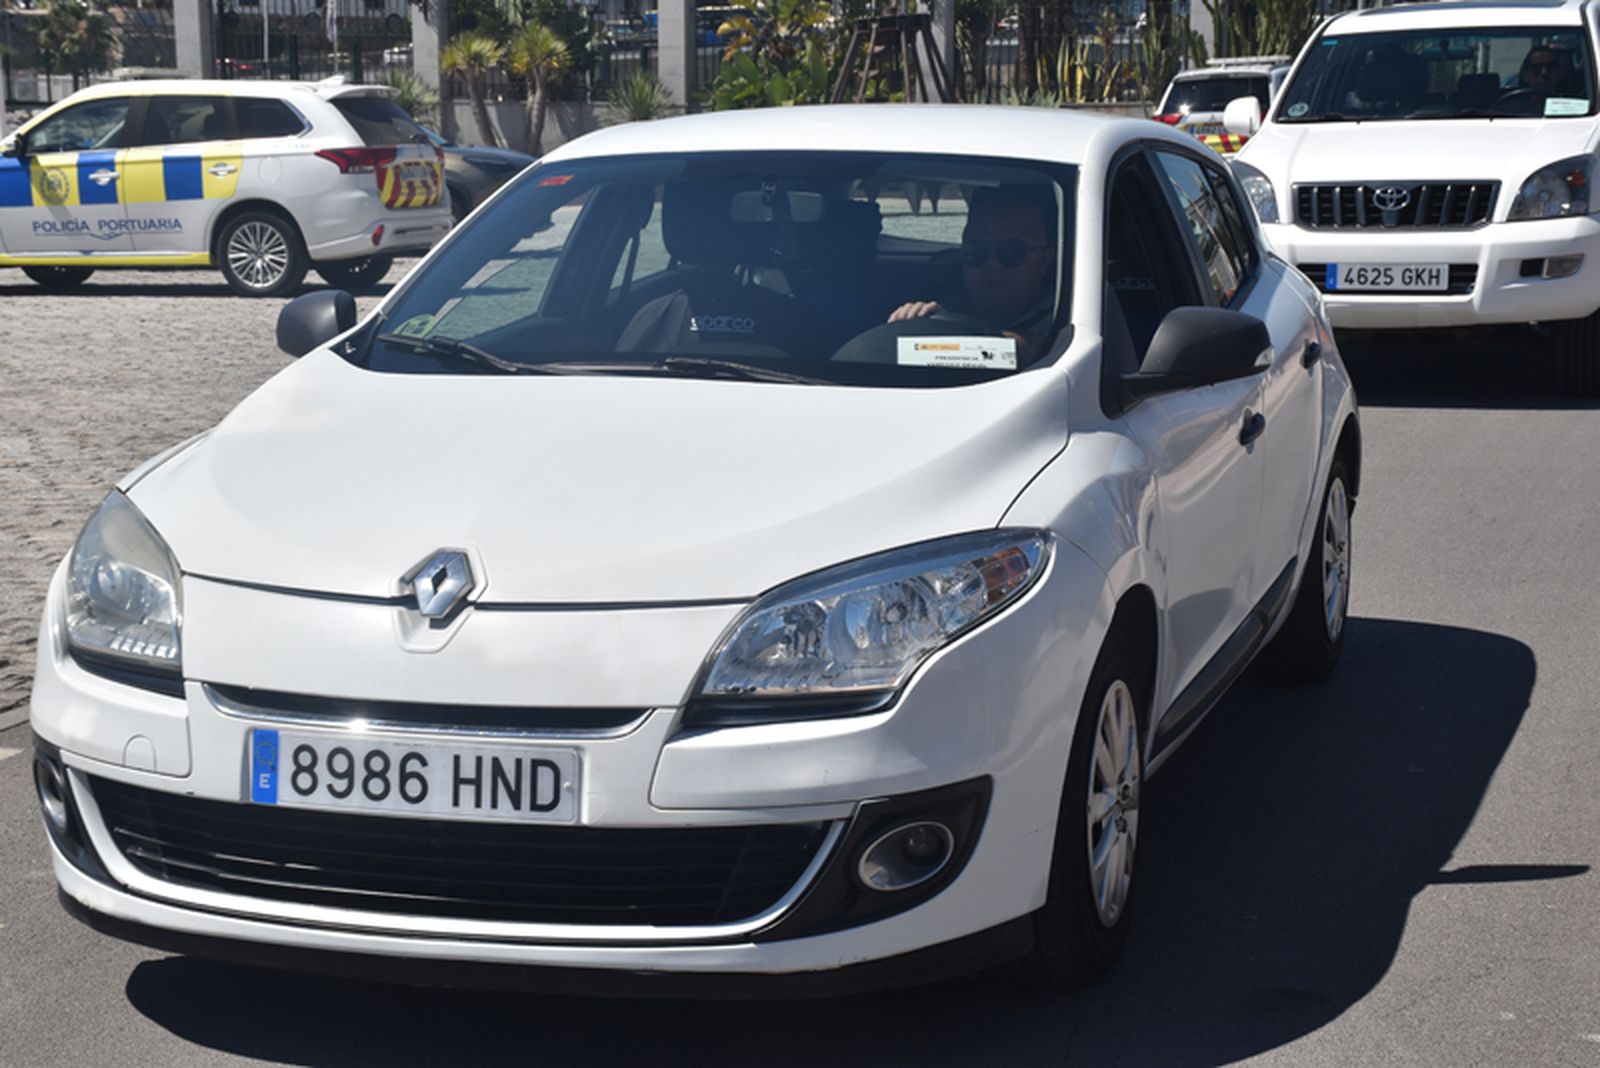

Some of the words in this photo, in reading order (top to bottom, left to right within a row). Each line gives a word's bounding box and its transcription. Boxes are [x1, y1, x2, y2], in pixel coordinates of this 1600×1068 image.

[98, 217, 183, 232] PORTUARIA
[1343, 267, 1395, 286] 4625
[1401, 267, 1441, 286] GKH
[258, 773, 271, 789] E
[290, 743, 429, 804] 8986
[451, 754, 562, 813] HND
